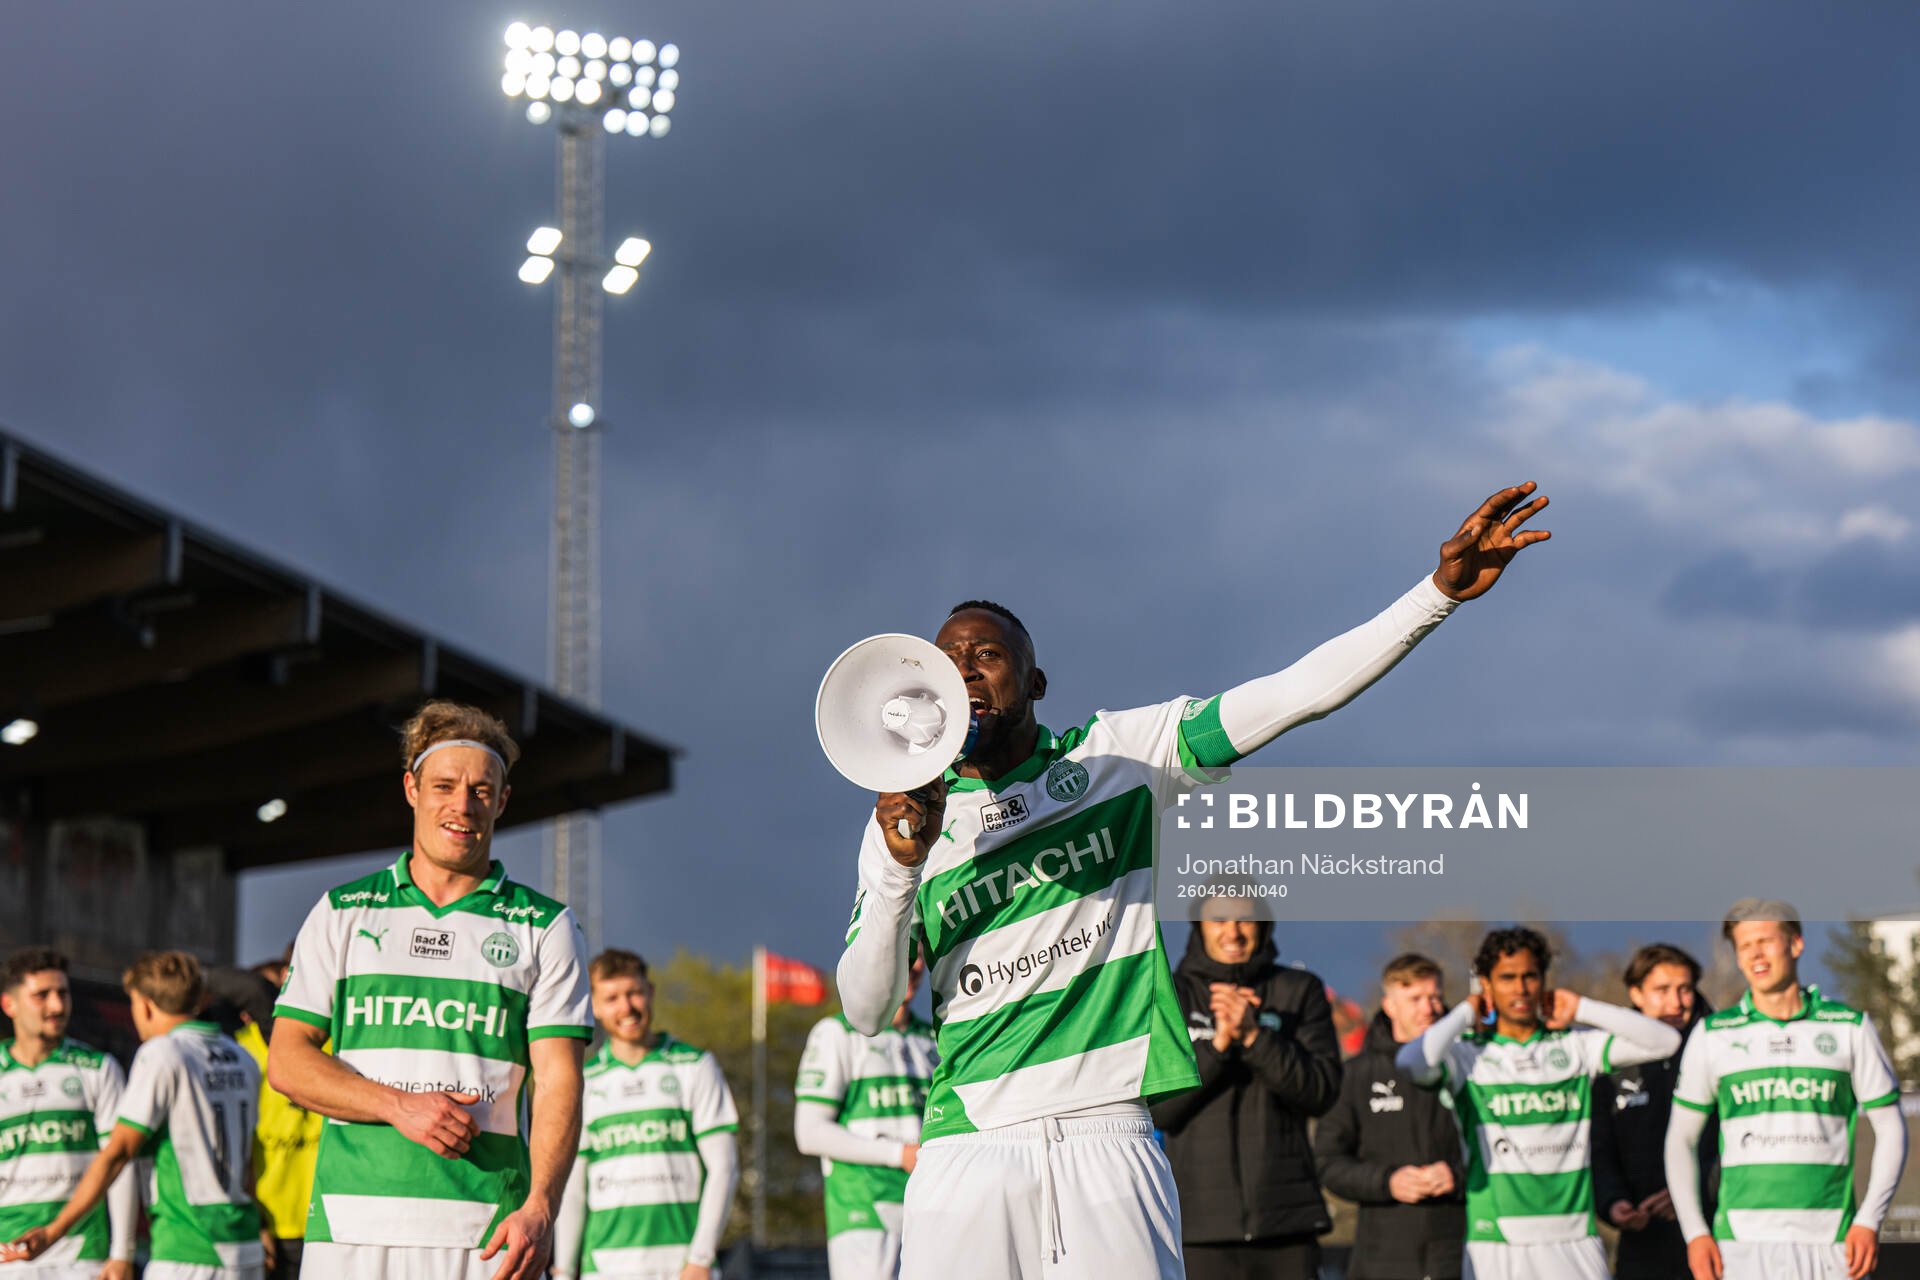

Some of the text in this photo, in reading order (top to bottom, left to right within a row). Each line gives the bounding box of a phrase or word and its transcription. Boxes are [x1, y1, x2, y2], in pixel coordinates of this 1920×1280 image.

[985, 799, 1025, 823] Bad &
[936, 826, 1116, 931] HITACHI
[414, 945, 450, 957] Värme
[415, 933, 450, 947] Bad &
[345, 995, 508, 1038] HITACHI
[1730, 1077, 1837, 1105] HITACHI
